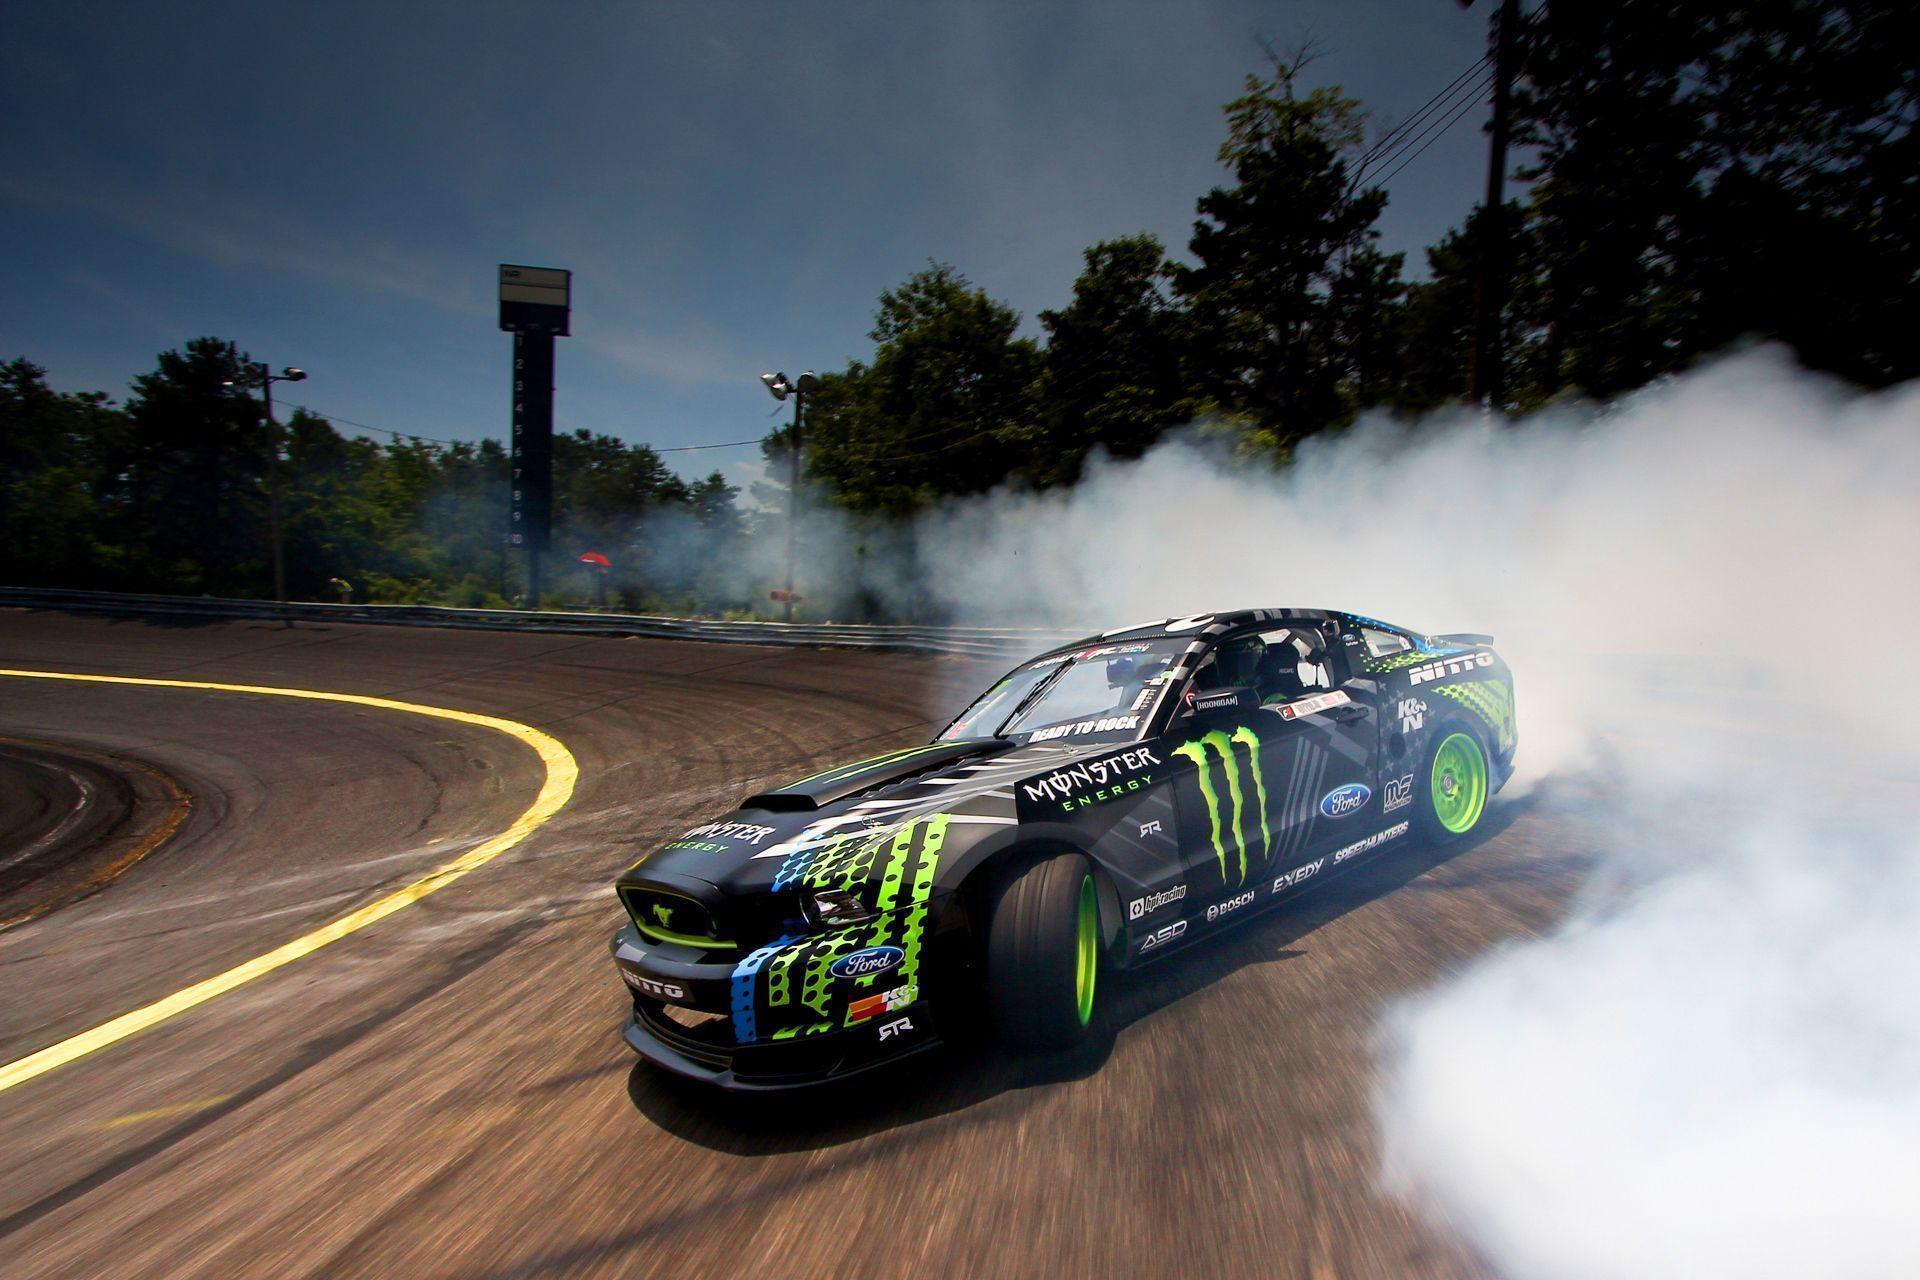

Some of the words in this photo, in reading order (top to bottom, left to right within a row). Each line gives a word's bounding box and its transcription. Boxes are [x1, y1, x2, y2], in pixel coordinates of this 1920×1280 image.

[515, 359, 524, 369] 2
[515, 381, 524, 391] 3
[514, 403, 524, 413] 4
[514, 425, 523, 435] 5
[514, 447, 523, 457] 6
[513, 468, 522, 479] 7
[512, 490, 522, 500] 8
[511, 511, 521, 522] 9
[511, 534, 523, 545] 10
[1408, 652, 1494, 686] NITTO
[1028, 724, 1076, 744] READY
[1073, 720, 1097, 736] TO
[1094, 715, 1141, 733] ROCK
[1023, 747, 1161, 802] MONSTER
[1062, 775, 1152, 812] ENERGY
[664, 841, 729, 853] ENERGY
[1271, 857, 1325, 895] EXEDY
[1219, 890, 1255, 916] BOSCH
[1140, 919, 1188, 951] ASD
[845, 951, 891, 975] Ford
